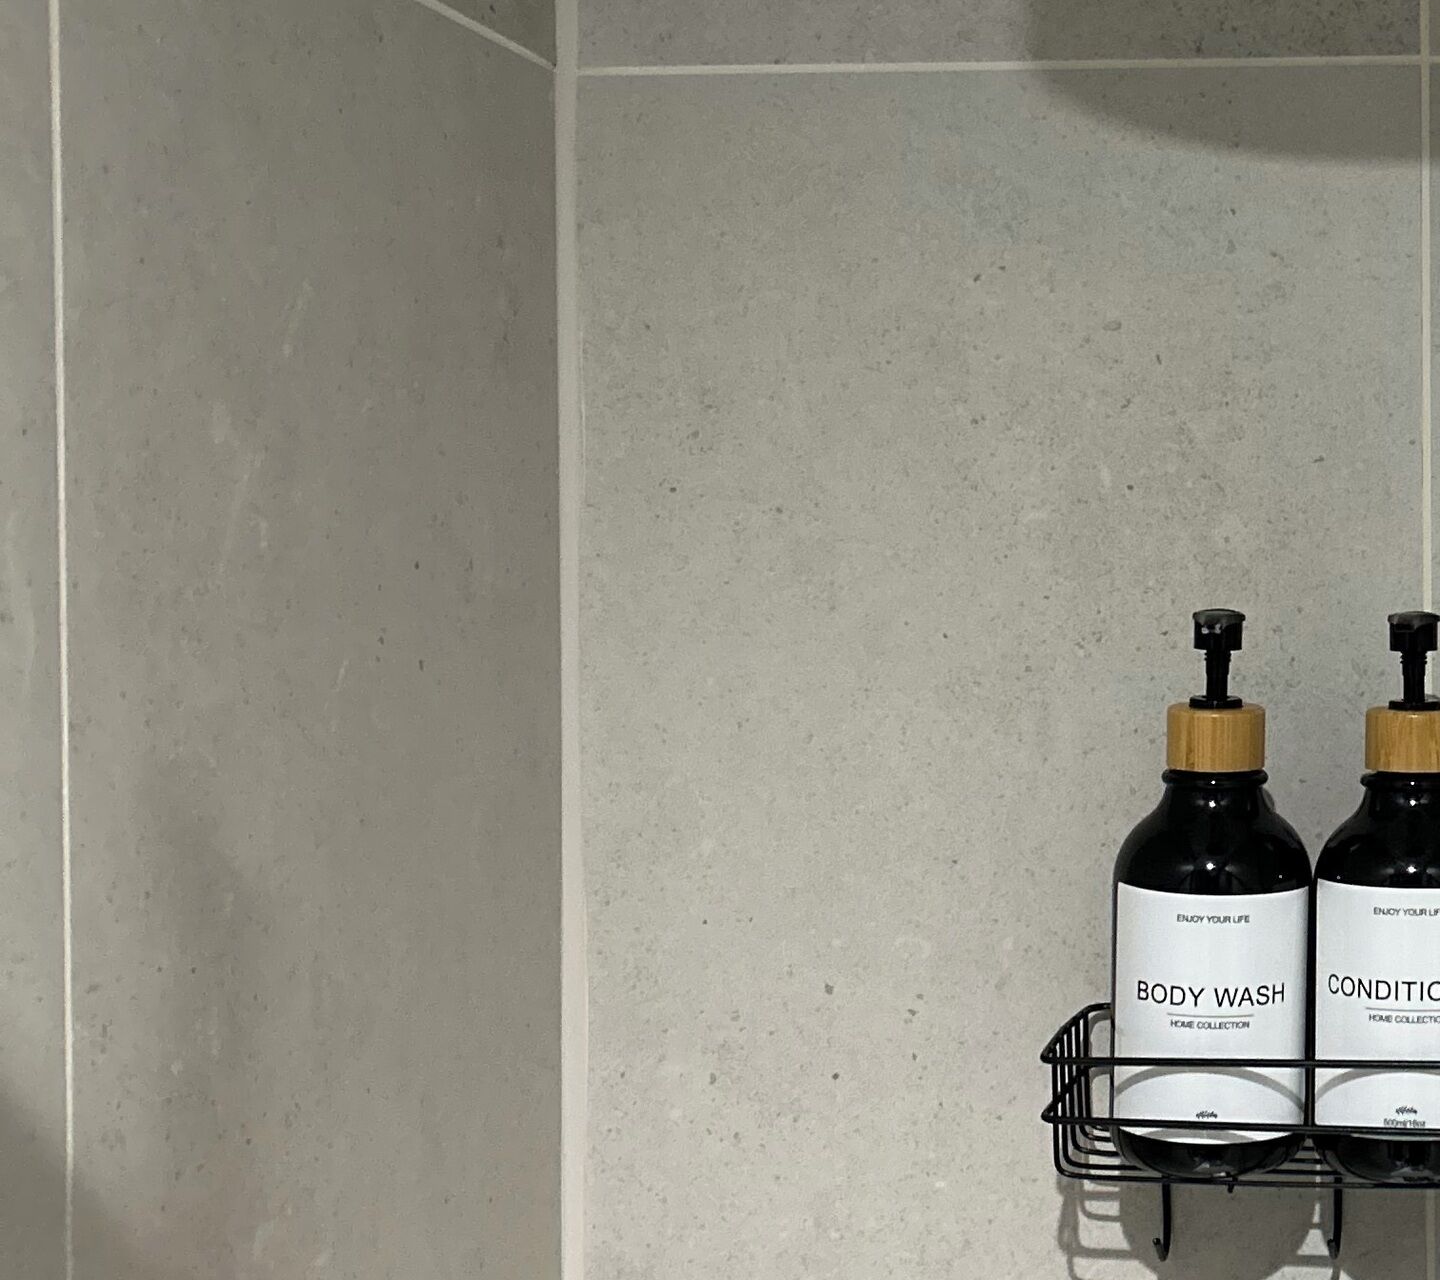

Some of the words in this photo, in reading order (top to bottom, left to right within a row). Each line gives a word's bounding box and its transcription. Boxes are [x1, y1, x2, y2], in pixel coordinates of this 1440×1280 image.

[1372, 906, 1401, 917] ENJOY
[1402, 907, 1427, 917] YOUR
[1176, 913, 1205, 924] ENJOY
[1206, 914, 1231, 924] YOUR
[1232, 914, 1250, 924] LIFE
[1136, 980, 1205, 1008] BODY
[1213, 982, 1285, 1008] WASH
[1368, 1013, 1393, 1024] HOME
[1170, 1019, 1195, 1029] HOME
[1196, 1021, 1250, 1030] COLLECTION
